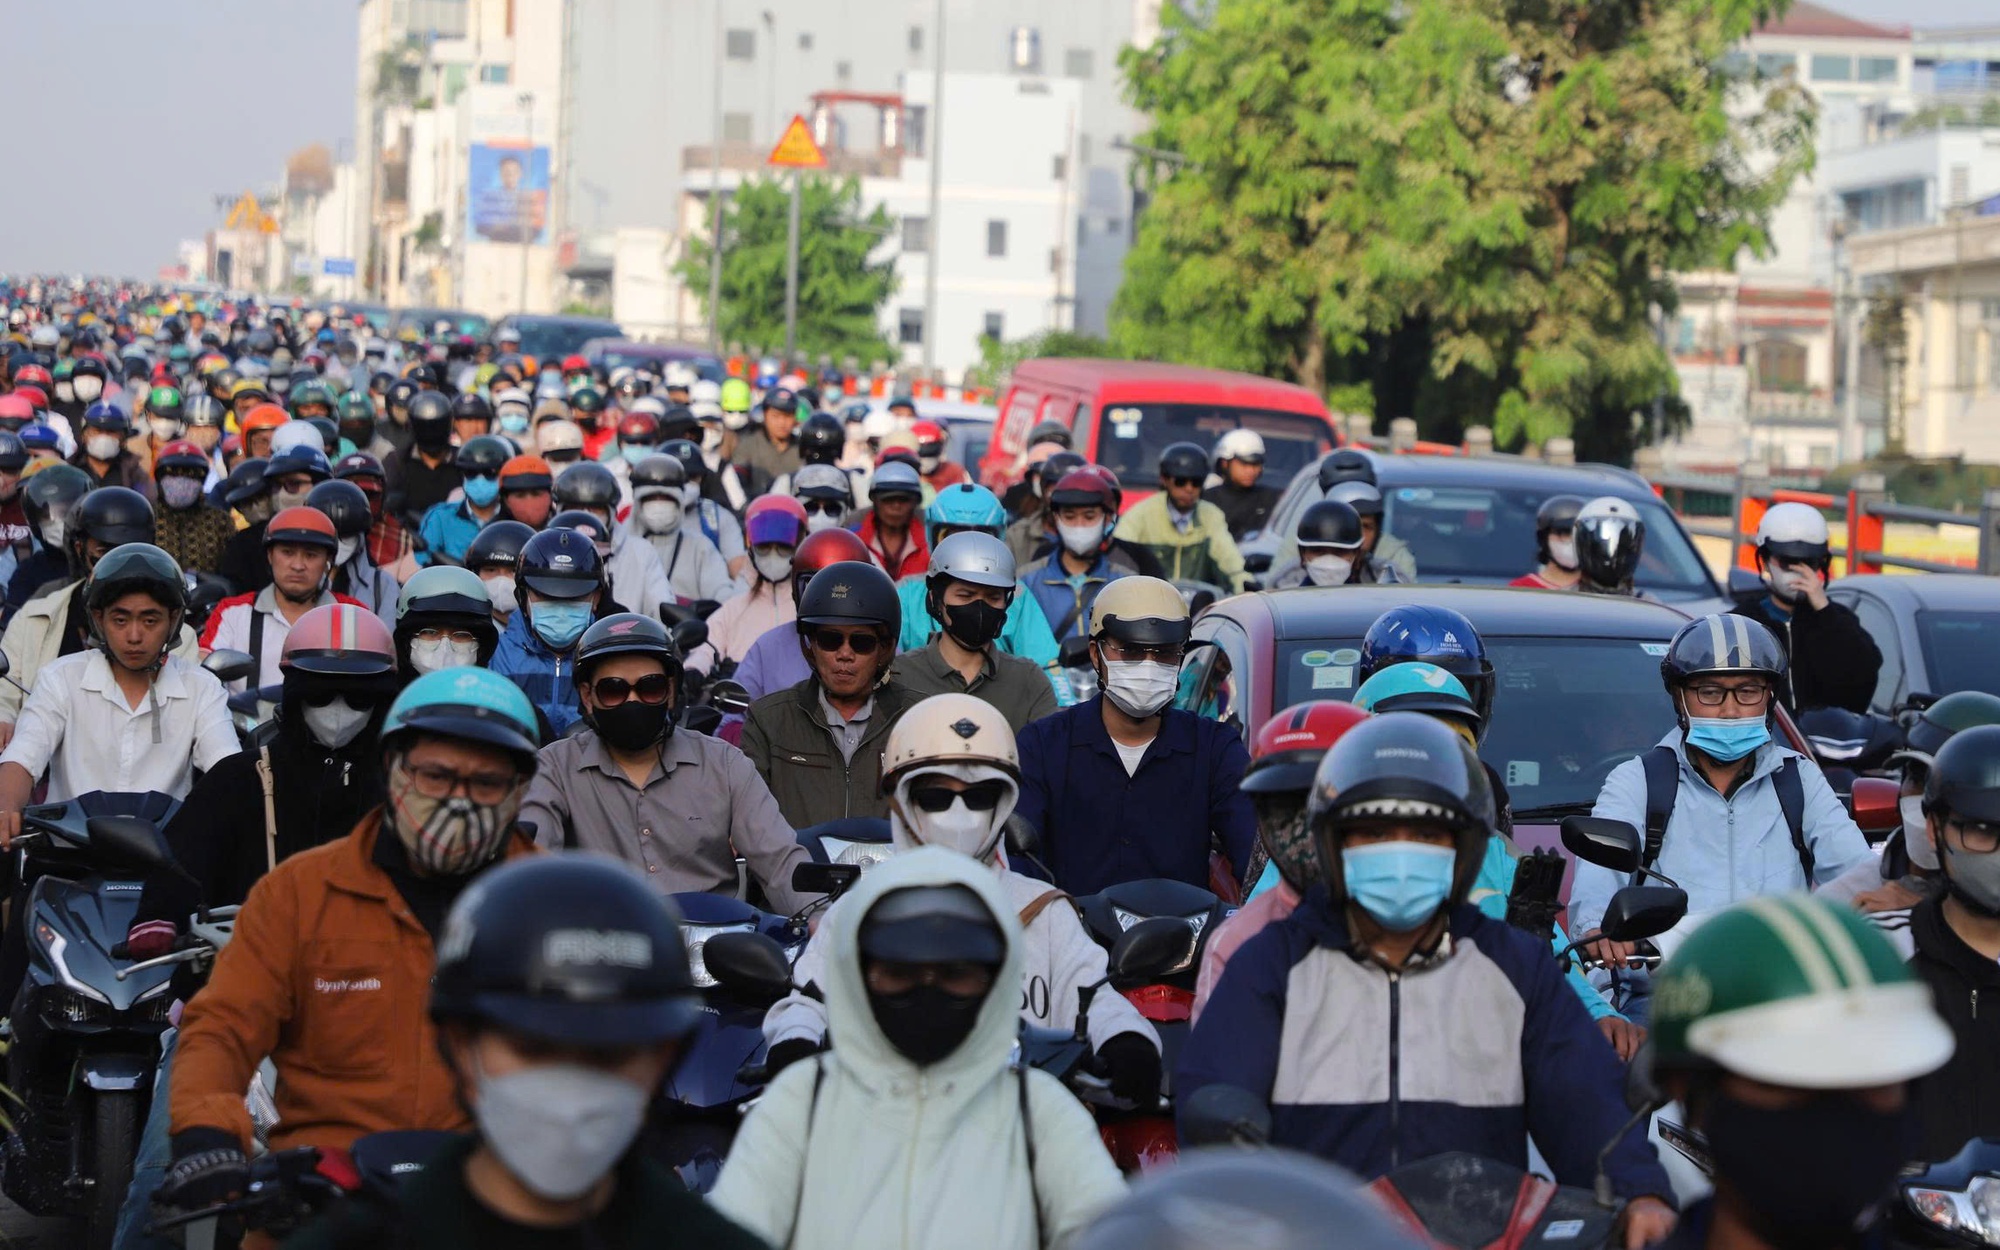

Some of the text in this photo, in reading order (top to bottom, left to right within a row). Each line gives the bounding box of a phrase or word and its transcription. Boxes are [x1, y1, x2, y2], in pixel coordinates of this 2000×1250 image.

[1274, 732, 1316, 744] HONDA
[1374, 748, 1430, 761] HONDA
[314, 977, 381, 993] DynYouth
